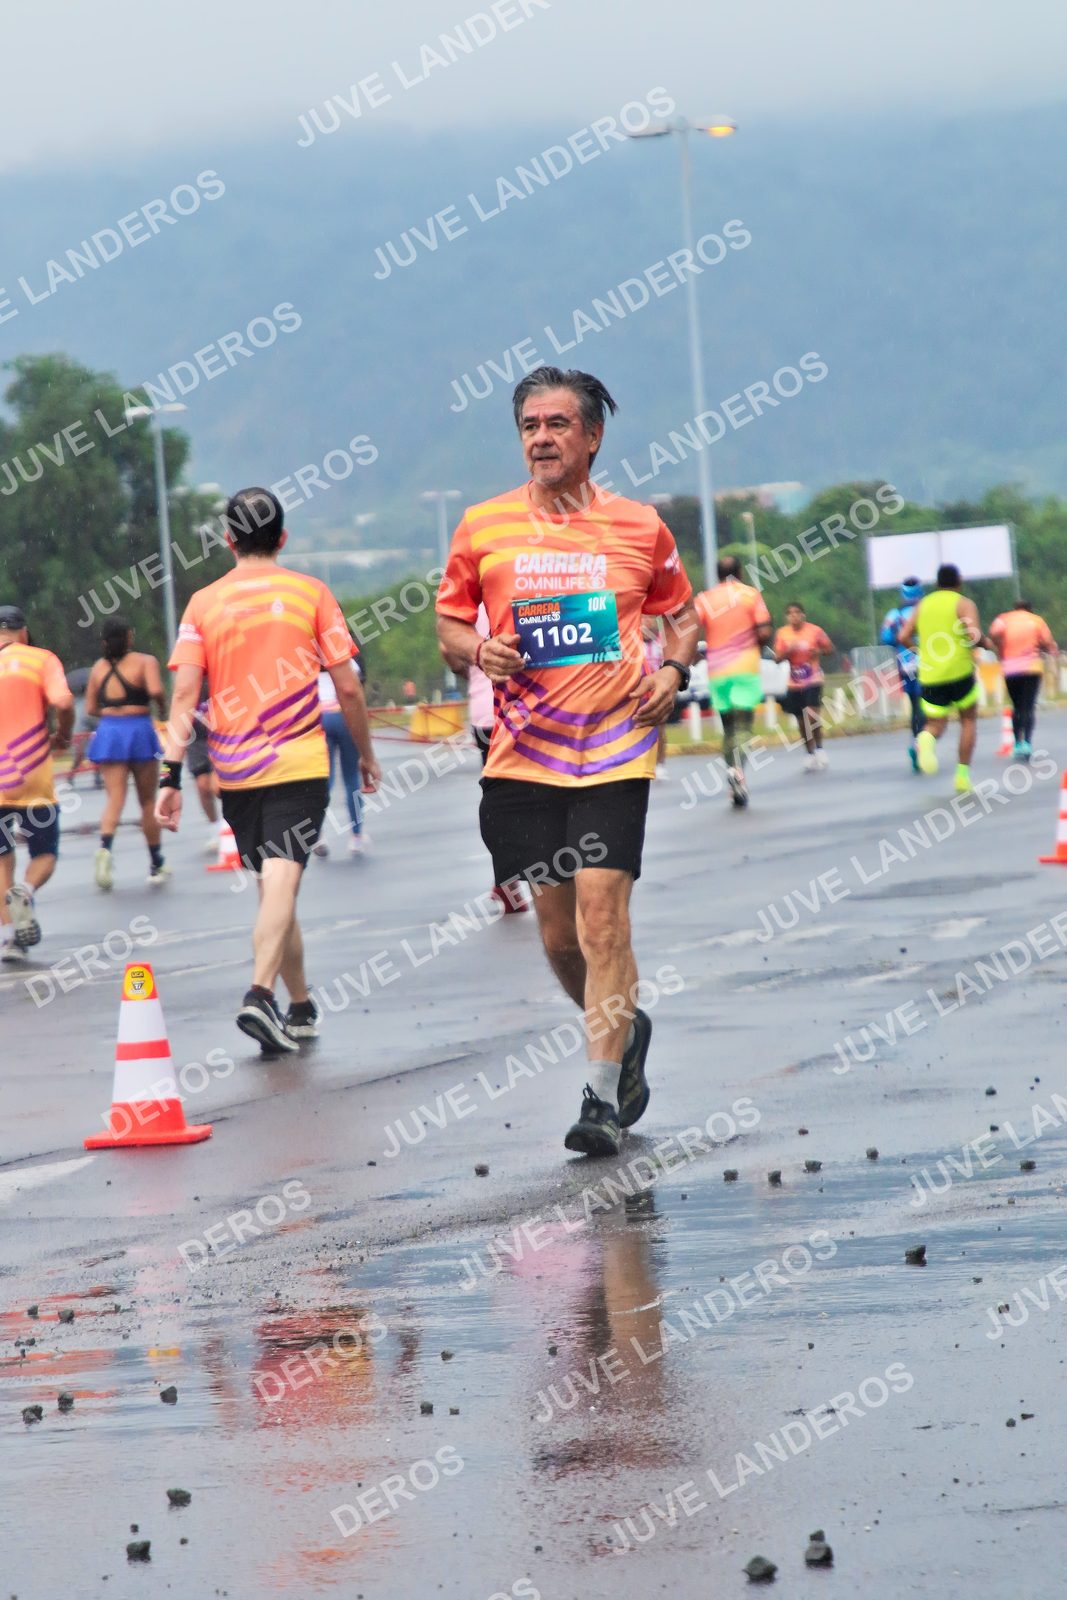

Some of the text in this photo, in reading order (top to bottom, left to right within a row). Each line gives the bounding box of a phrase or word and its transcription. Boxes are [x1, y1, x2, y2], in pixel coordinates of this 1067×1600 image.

[514, 552, 607, 577] CARRERA
[515, 576, 585, 590] OMNILIFE
[518, 602, 560, 617] CARRERA
[588, 596, 607, 612] 10K
[519, 614, 552, 625] OMNILIFE
[532, 622, 594, 648] 1102
